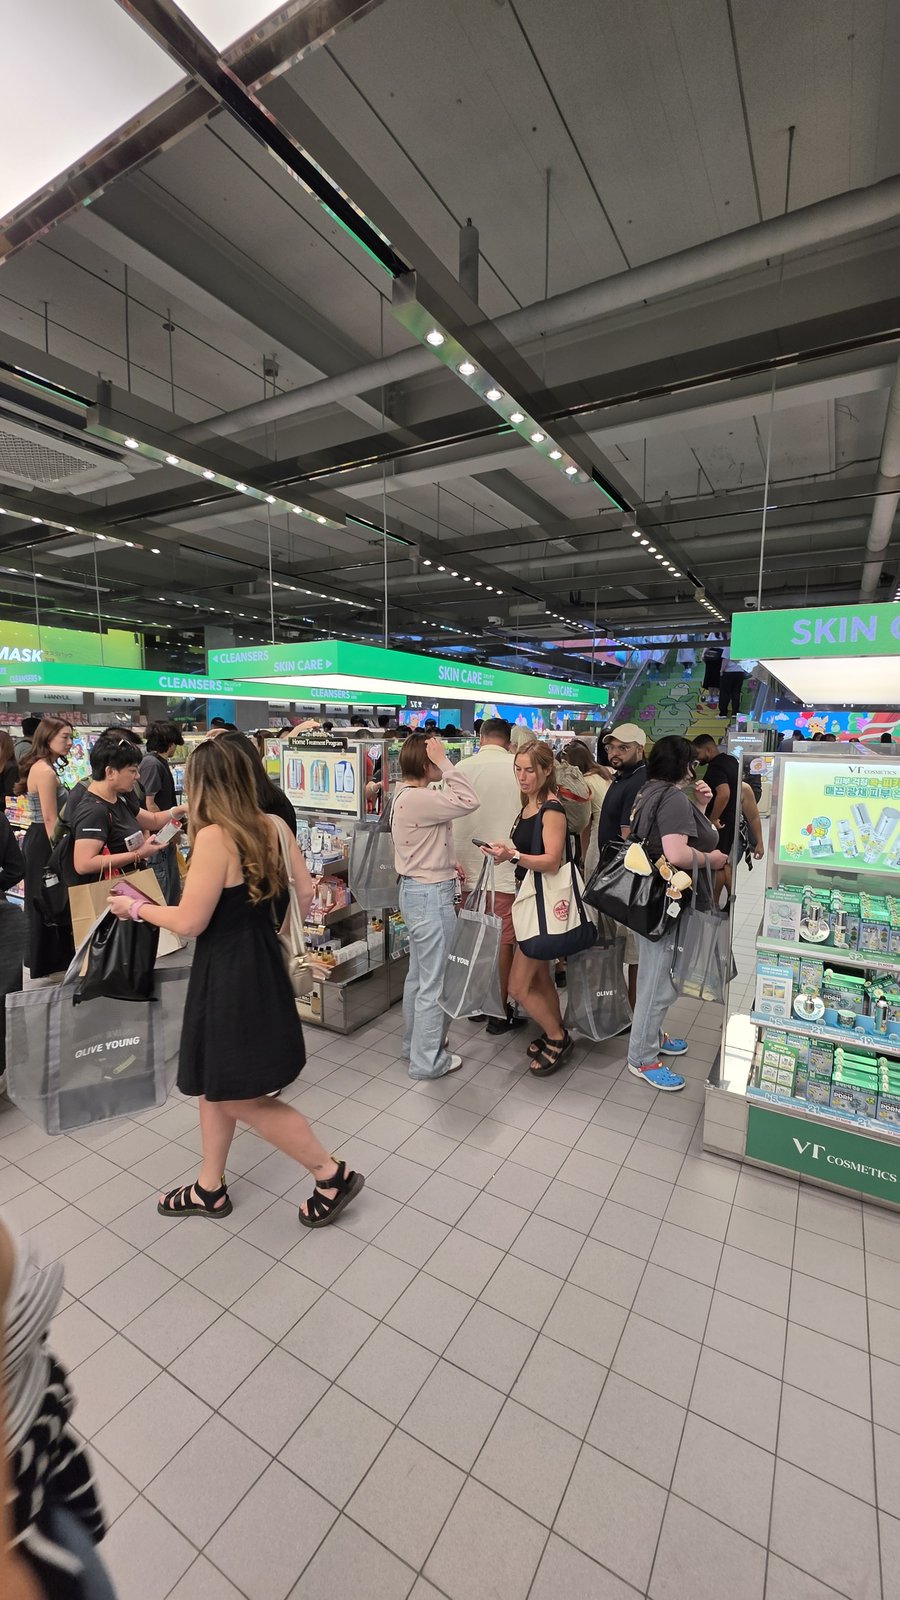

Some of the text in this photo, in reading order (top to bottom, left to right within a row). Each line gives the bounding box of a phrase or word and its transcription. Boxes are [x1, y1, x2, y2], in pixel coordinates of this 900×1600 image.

[791, 615, 877, 645] SKIN
[0, 646, 43, 662] MASK
[220, 651, 269, 664] CLEANSERS
[273, 659, 323, 673] SKIN CARE
[438, 665, 460, 682] SKIN
[461, 670, 483, 686] CARE
[158, 676, 223, 692] CLEANSERS
[548, 684, 560, 695] SKIN
[560, 686, 573, 697] CARE
[310, 688, 350, 699] CLEANSERS
[292, 738, 343, 748] Home Treatment Program
[848, 765, 864, 774] VT
[75, 1036, 141, 1058] OLIVE YOUNG
[792, 1137, 897, 1182] VT COSMETICS
